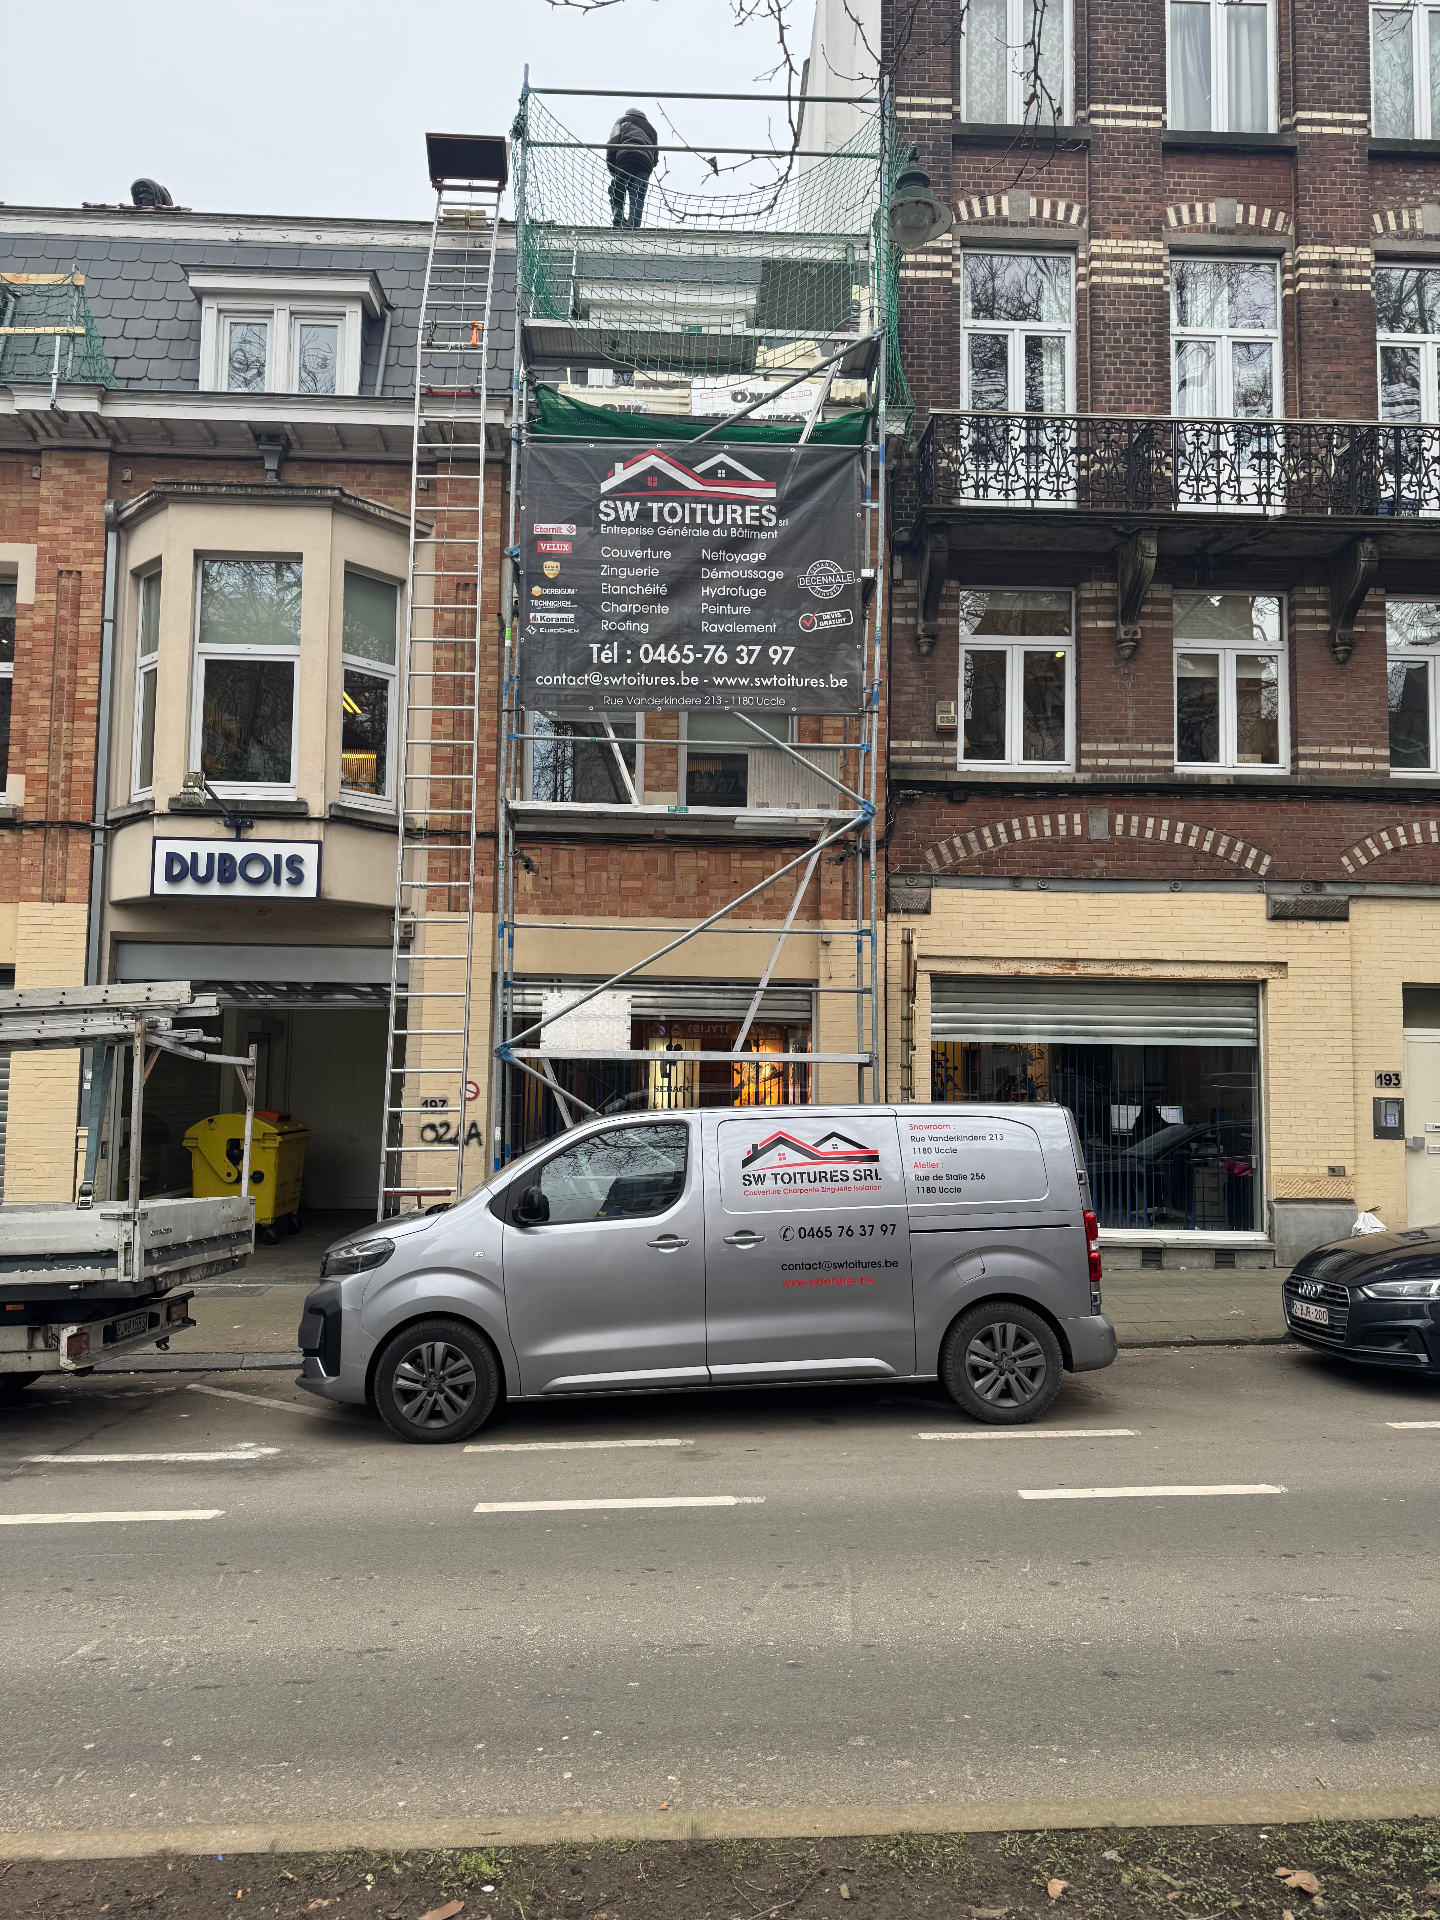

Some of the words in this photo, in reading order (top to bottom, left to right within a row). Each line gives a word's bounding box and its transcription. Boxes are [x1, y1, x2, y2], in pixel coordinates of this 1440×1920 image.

[599, 500, 640, 522] SW
[647, 502, 777, 526] TOITURES
[778, 518, 789, 527] srl
[534, 524, 563, 534] Eternit
[601, 524, 654, 536] Entreprise
[657, 525, 709, 537] Générale
[712, 527, 727, 537] du
[730, 527, 778, 540] Bâtiment
[540, 543, 570, 551] VELUX
[601, 546, 672, 559] Couverture
[701, 549, 767, 563] Nettoyage
[600, 564, 660, 579] Zinguerie
[701, 567, 784, 582] Démoussage
[799, 573, 853, 586] DECENNALE
[601, 583, 668, 596] Etanchéité
[701, 586, 767, 600] Hydrofuge
[601, 601, 670, 615] Charpente
[701, 603, 751, 615] Peinture
[539, 615, 574, 623] Koramic
[601, 619, 649, 634] Roofing
[701, 621, 777, 633] Ravalement
[589, 642, 618, 664] Tél
[639, 643, 728, 665] 0465-76
[735, 645, 762, 665] 37
[768, 646, 796, 666] 97
[535, 670, 699, 686] contact@swtoitures.be
[712, 673, 848, 688] www.swtoitures.be
[603, 696, 623, 705] Rue
[626, 696, 701, 705] Vanderkindere
[704, 696, 722, 705] 213
[732, 697, 754, 706] 1180
[756, 697, 786, 706] Uccle
[165, 851, 305, 886] DUBOIS
[1376, 1073, 1401, 1087] 193
[909, 1123, 951, 1131] Showroom
[910, 1135, 926, 1143] Rue
[927, 1134, 987, 1142] Vanderkindere
[988, 1133, 1004, 1141] 213
[912, 1147, 932, 1155] 1180
[934, 1146, 958, 1154] Uccle
[913, 1161, 939, 1169] Atelier
[742, 1173, 767, 1187] SW
[770, 1170, 850, 1186] TOITURES
[852, 1168, 883, 1182] SRL
[914, 1174, 930, 1182] Rue
[932, 1173, 944, 1181] de
[945, 1173, 968, 1181] Stalle
[970, 1172, 986, 1180] 256
[743, 1188, 782, 1197] Couverture
[783, 1186, 820, 1196] Charpente
[821, 1185, 852, 1194] Zinguerie
[854, 1184, 882, 1192] Isolation
[916, 1186, 937, 1194] 1180
[938, 1186, 962, 1194] Uccle
[798, 1226, 833, 1239] 0465
[837, 1225, 855, 1238] 76
[859, 1224, 875, 1237] 37
[880, 1223, 897, 1236] 97
[781, 1259, 899, 1271] contact@swtoitures.be
[782, 1275, 875, 1287] www.swtoitures.be
